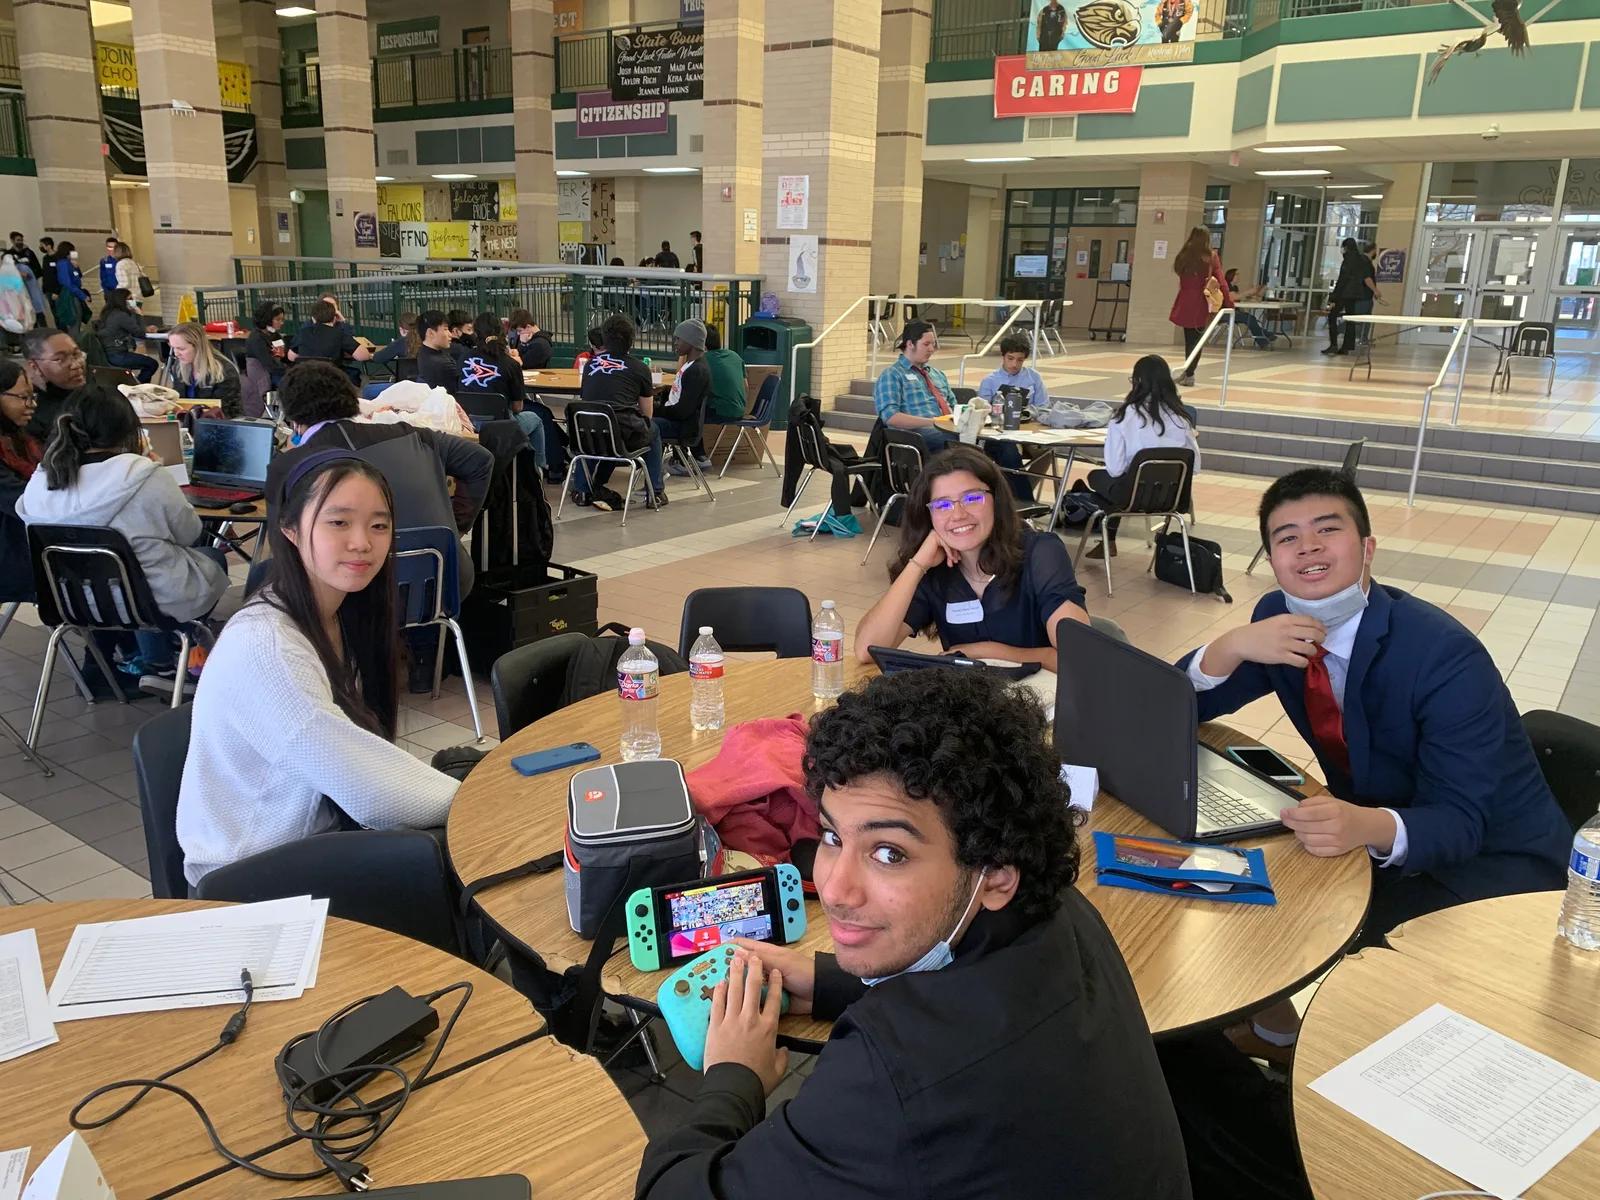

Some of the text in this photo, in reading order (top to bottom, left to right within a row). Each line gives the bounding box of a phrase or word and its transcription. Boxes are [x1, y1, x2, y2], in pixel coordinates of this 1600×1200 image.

[380, 29, 438, 50] RESPONSIBILITY
[633, 34, 668, 49] State
[100, 46, 133, 66] JOIN
[617, 50, 636, 65] Good
[636, 49, 656, 63] Luck
[1072, 49, 1101, 67] Good
[102, 65, 137, 83] CHO
[617, 66, 632, 76] JOSH
[633, 65, 662, 75] MARTINEZ
[621, 76, 641, 86] TAYLOR
[642, 75, 657, 85] RICH
[1011, 70, 1120, 99] CARING
[637, 85, 690, 96] JEANNIE HAWKINS
[580, 101, 666, 124] CITIZENSHIP
[387, 202, 422, 222] FALCONS
[486, 237, 517, 250] THE NEST
